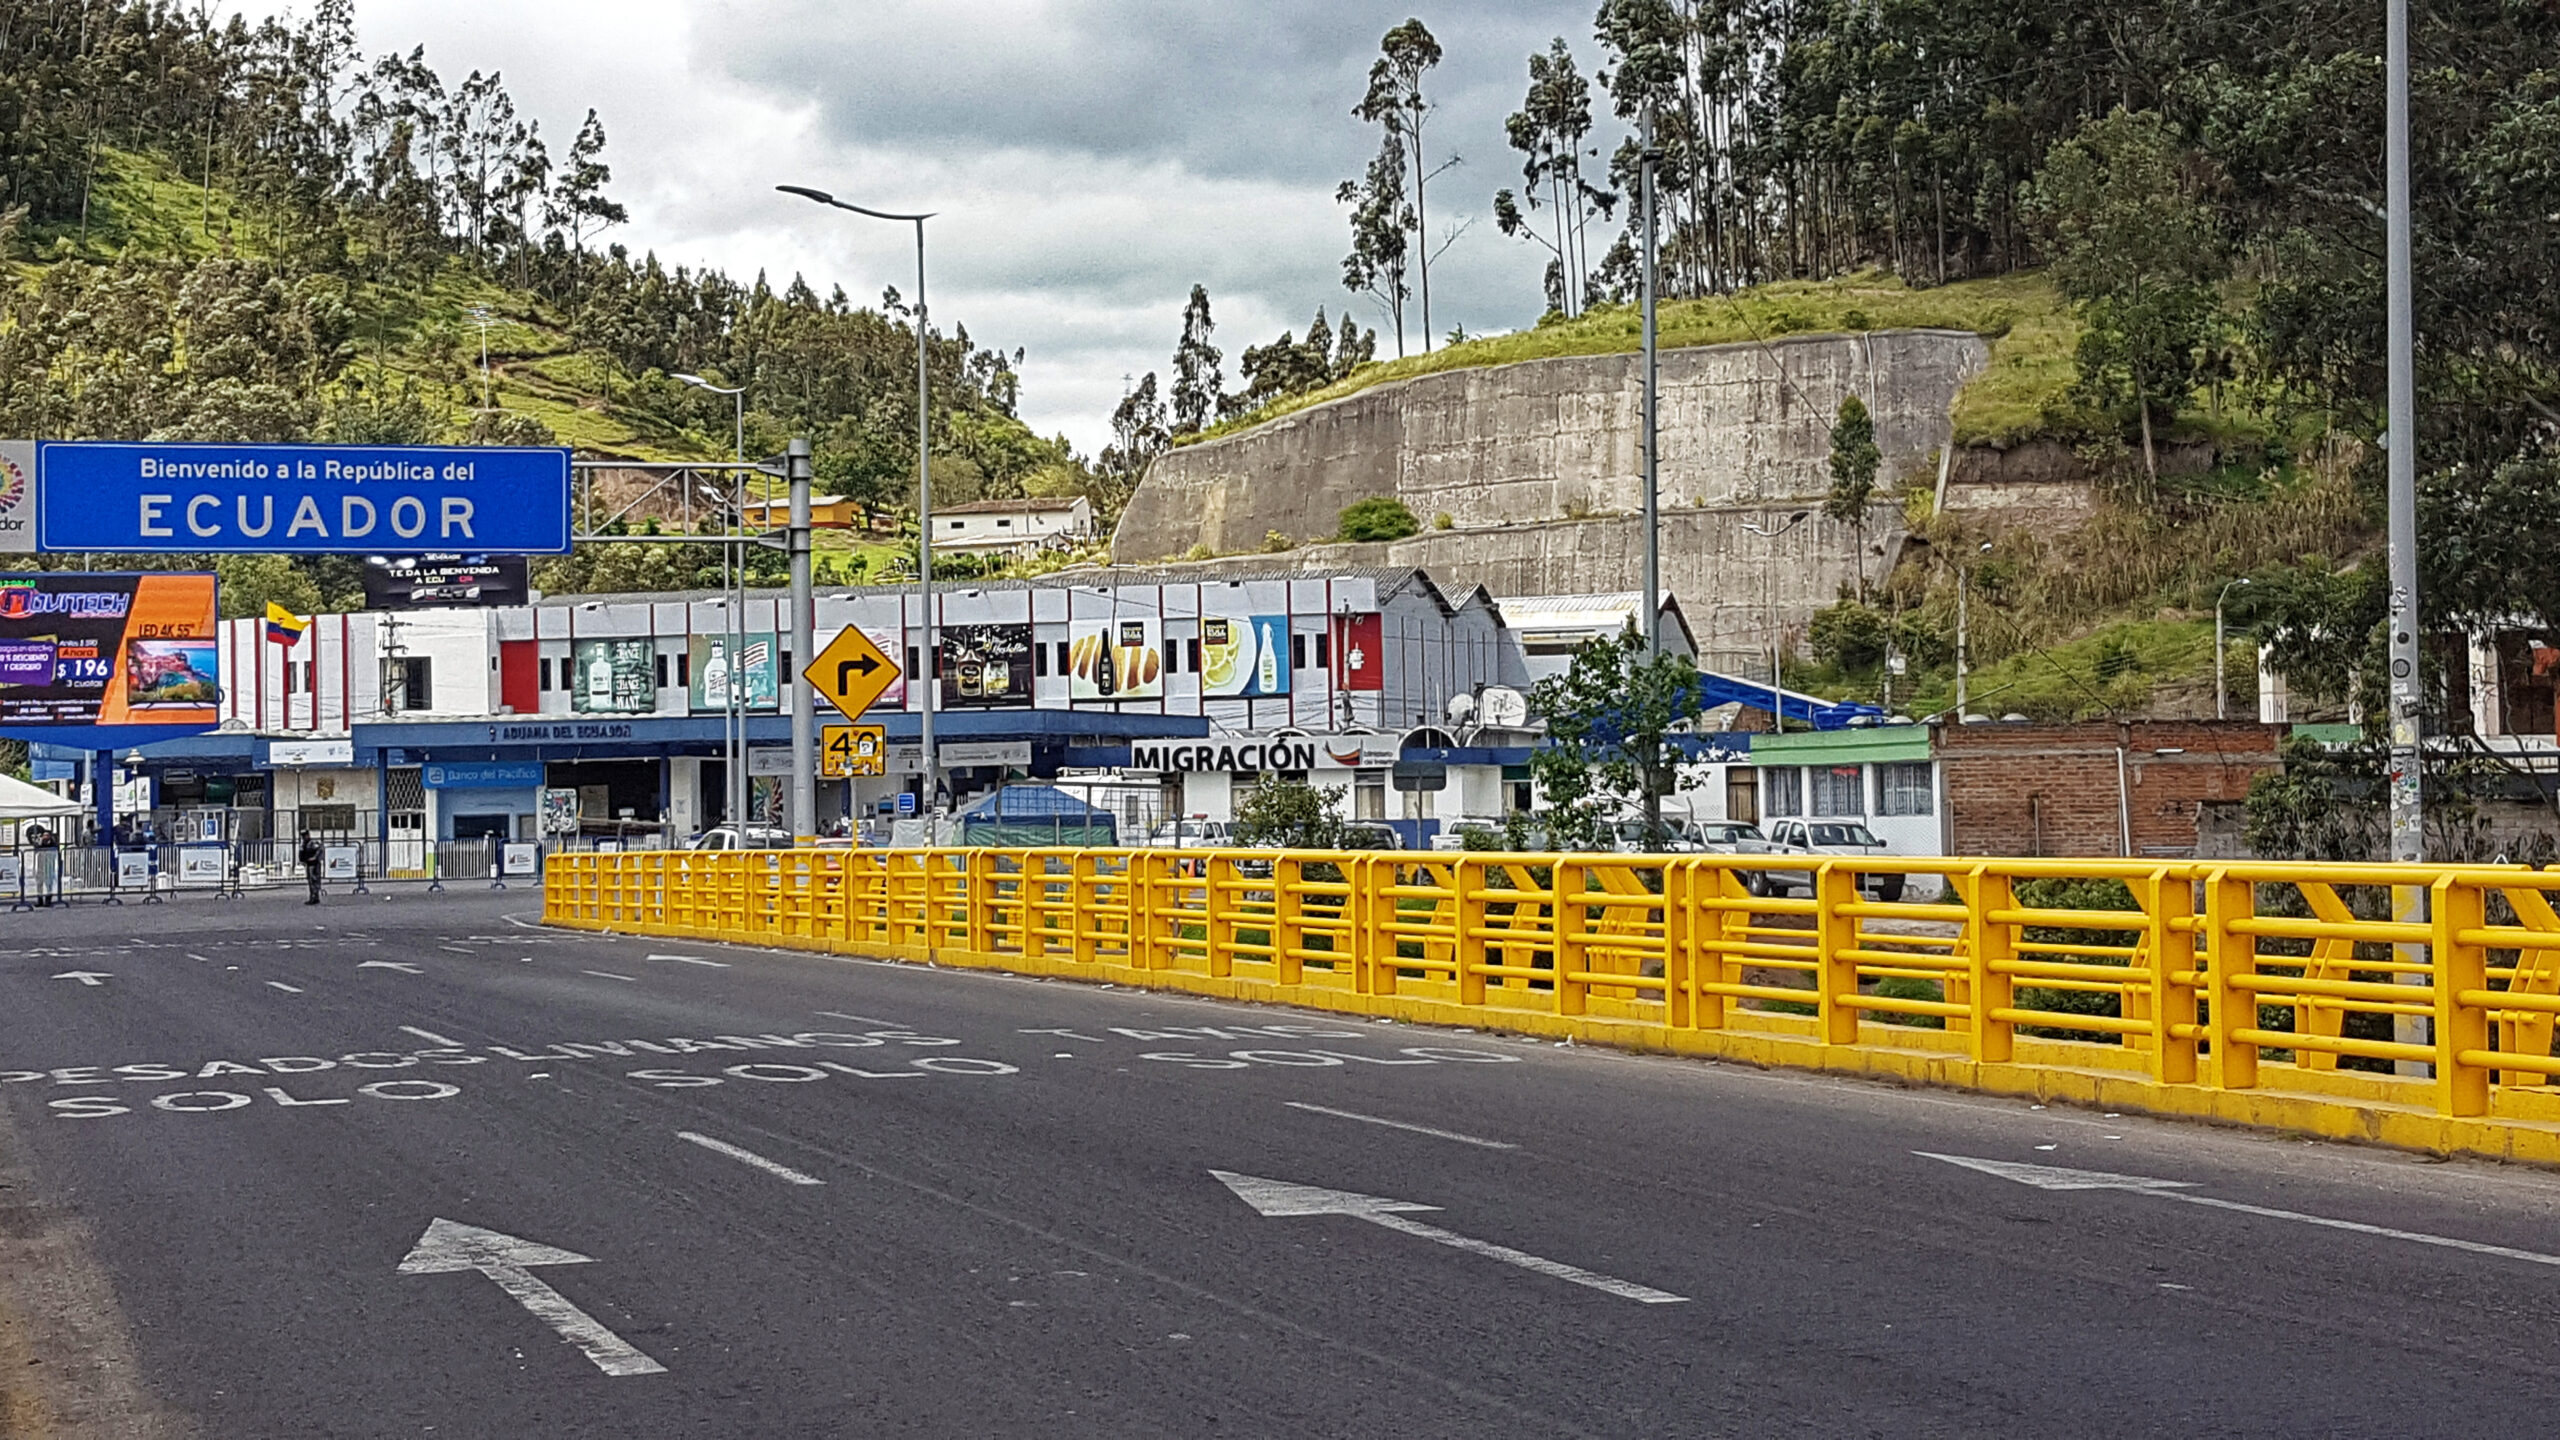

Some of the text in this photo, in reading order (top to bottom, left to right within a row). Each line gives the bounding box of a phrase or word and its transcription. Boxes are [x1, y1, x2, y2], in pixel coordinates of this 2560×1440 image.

[140, 457, 475, 484] Bienvenido a la República del
[139, 493, 475, 539] ECUADOR
[390, 567, 499, 577] TE DA LA BIENVENIDA
[414, 575, 474, 584] A ECUOR
[2, 587, 131, 614] MOVITECH
[138, 623, 159, 638] LED
[160, 623, 175, 638] 4K
[62, 648, 94, 657] Ahora
[57, 659, 108, 679] $ 196
[503, 724, 632, 740] ADUANA DEL ECUADOR
[1133, 738, 1315, 772] MIGRACIÓN
[447, 769, 479, 781] Banco
[480, 769, 496, 780] del
[1017, 1025, 1366, 1043] TAXIS
[487, 1030, 962, 1062] LIVIANOS
[0, 1048, 488, 1088] PESADOS
[1138, 1047, 1523, 1069] SOLO
[627, 1056, 1020, 1088] SOLO
[47, 1080, 462, 1118] SOLO
